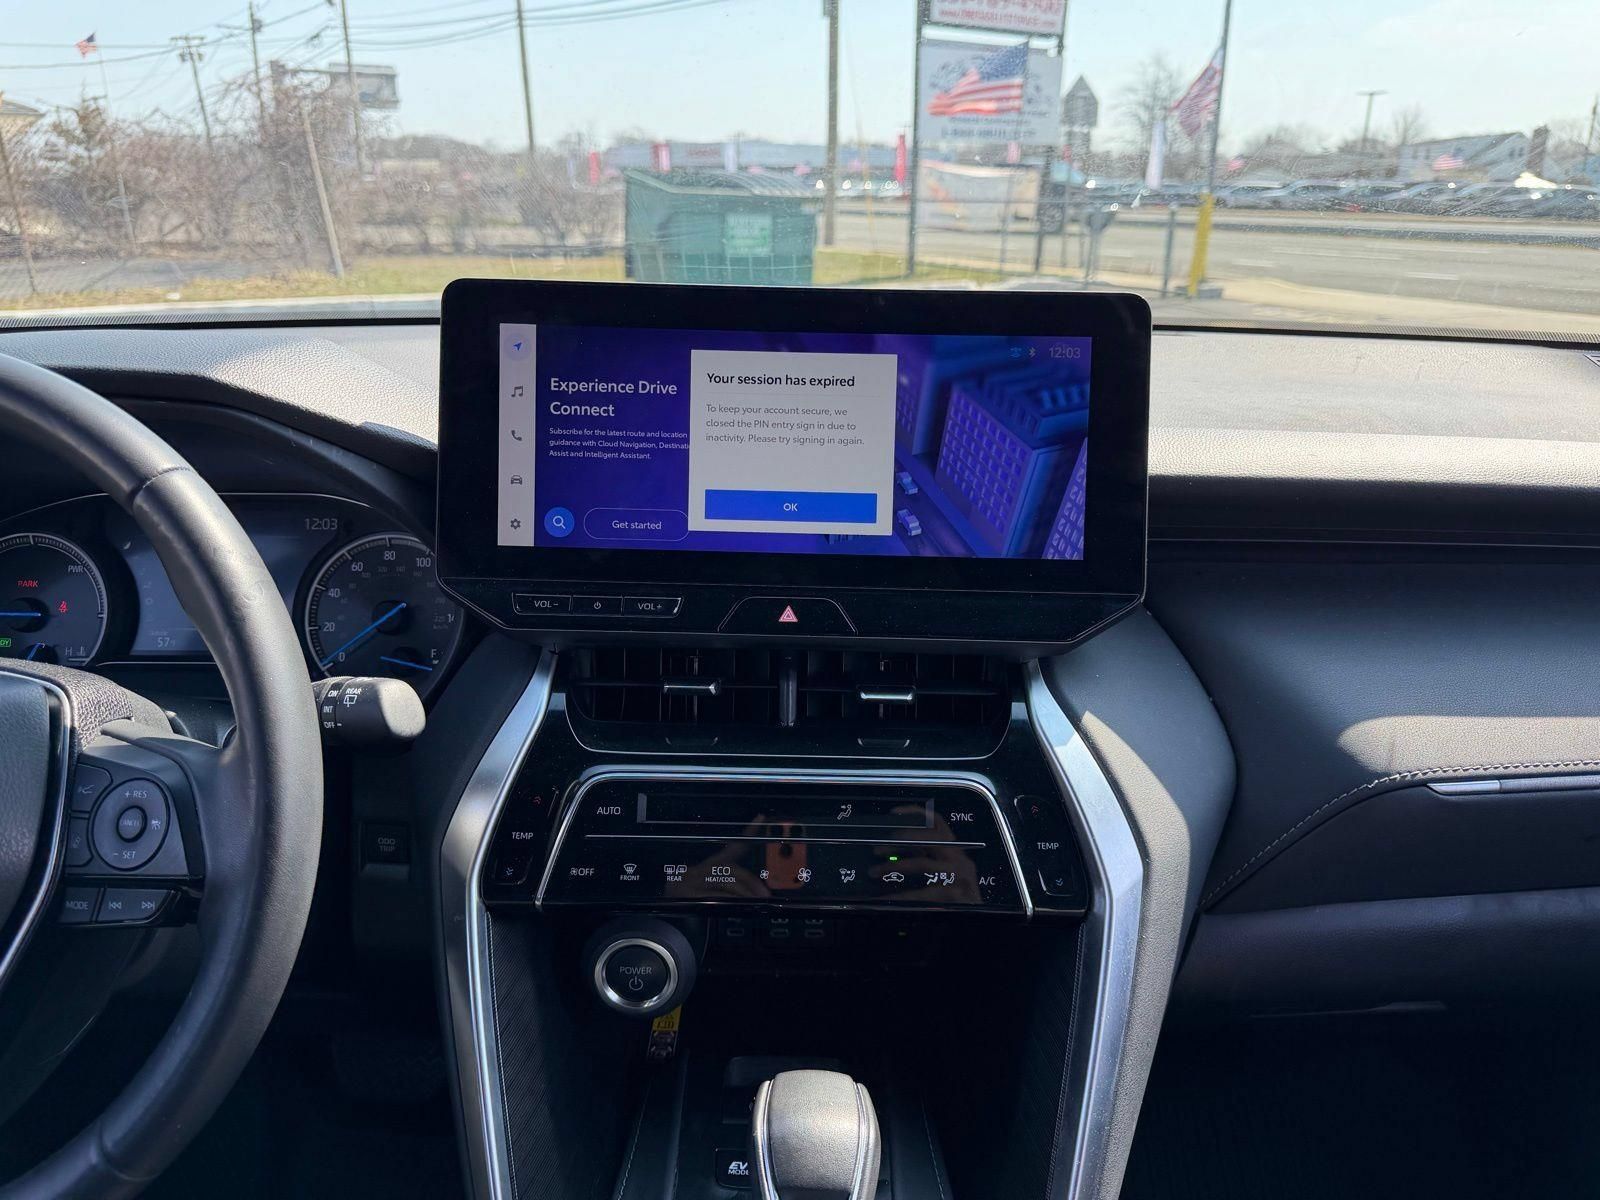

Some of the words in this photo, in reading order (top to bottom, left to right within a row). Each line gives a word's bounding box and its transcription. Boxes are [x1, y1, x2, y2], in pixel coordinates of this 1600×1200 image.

[1049, 347, 1081, 359] 12:03
[706, 373, 735, 384] Your
[737, 374, 782, 385] session
[785, 374, 807, 386] has
[809, 375, 856, 388] expired
[550, 378, 635, 394] Experience
[638, 380, 678, 395] Drive
[550, 401, 615, 417] Connect
[706, 404, 717, 413] To
[718, 404, 740, 415] keep
[742, 406, 762, 416] your
[764, 406, 800, 415] account
[801, 407, 833, 417] secure,
[706, 419, 735, 428] closed
[737, 419, 752, 428] the
[754, 420, 770, 428] PIN
[771, 421, 795, 431] entry
[796, 421, 815, 431] sign
[817, 421, 825, 430] in
[827, 421, 845, 430] due
[846, 422, 857, 430] to
[549, 427, 583, 436] Subscribe
[583, 428, 594, 436] for
[595, 428, 606, 436] the
[607, 429, 627, 437] latest
[646, 430, 660, 438] and
[661, 430, 688, 439] location
[549, 439, 581, 447] guidance
[582, 439, 597, 447] with
[598, 440, 619, 448] Cloud
[620, 440, 658, 449] Navigation,
[705, 434, 746, 444] inactivity.
[748, 434, 777, 443] Please
[778, 435, 791, 445] try
[792, 435, 825, 446] signing
[827, 436, 836, 444] in
[837, 437, 865, 446] again.
[570, 450, 583, 458] and
[584, 450, 619, 459] Intelligent
[620, 451, 652, 459] Assistant.
[783, 502, 798, 512] OK
[304, 518, 339, 531] 12:03
[612, 520, 628, 530] Get
[630, 520, 662, 531] started
[384, 551, 396, 561] 80
[351, 562, 364, 572] 60
[416, 557, 431, 568] 100
[68, 565, 84, 573] PWR
[17, 580, 39, 588] PARK
[328, 588, 341, 598] 40
[323, 621, 335, 632] 20
[65, 646, 73, 656] H
[431, 649, 438, 658] F
[338, 652, 346, 662] 0
[328, 690, 338, 698] ON
[324, 721, 335, 729] OFF
[597, 806, 621, 815] AUTO
[950, 812, 974, 822] SYNC
[512, 831, 534, 840] TEMP
[1037, 842, 1060, 850] TEMP
[122, 850, 137, 859] SET
[578, 867, 595, 876] OFF
[711, 866, 731, 876] ECO
[978, 876, 998, 886] A/C
[65, 901, 89, 910] MODE
[619, 966, 653, 976] POWER
[728, 1161, 748, 1170] EV
